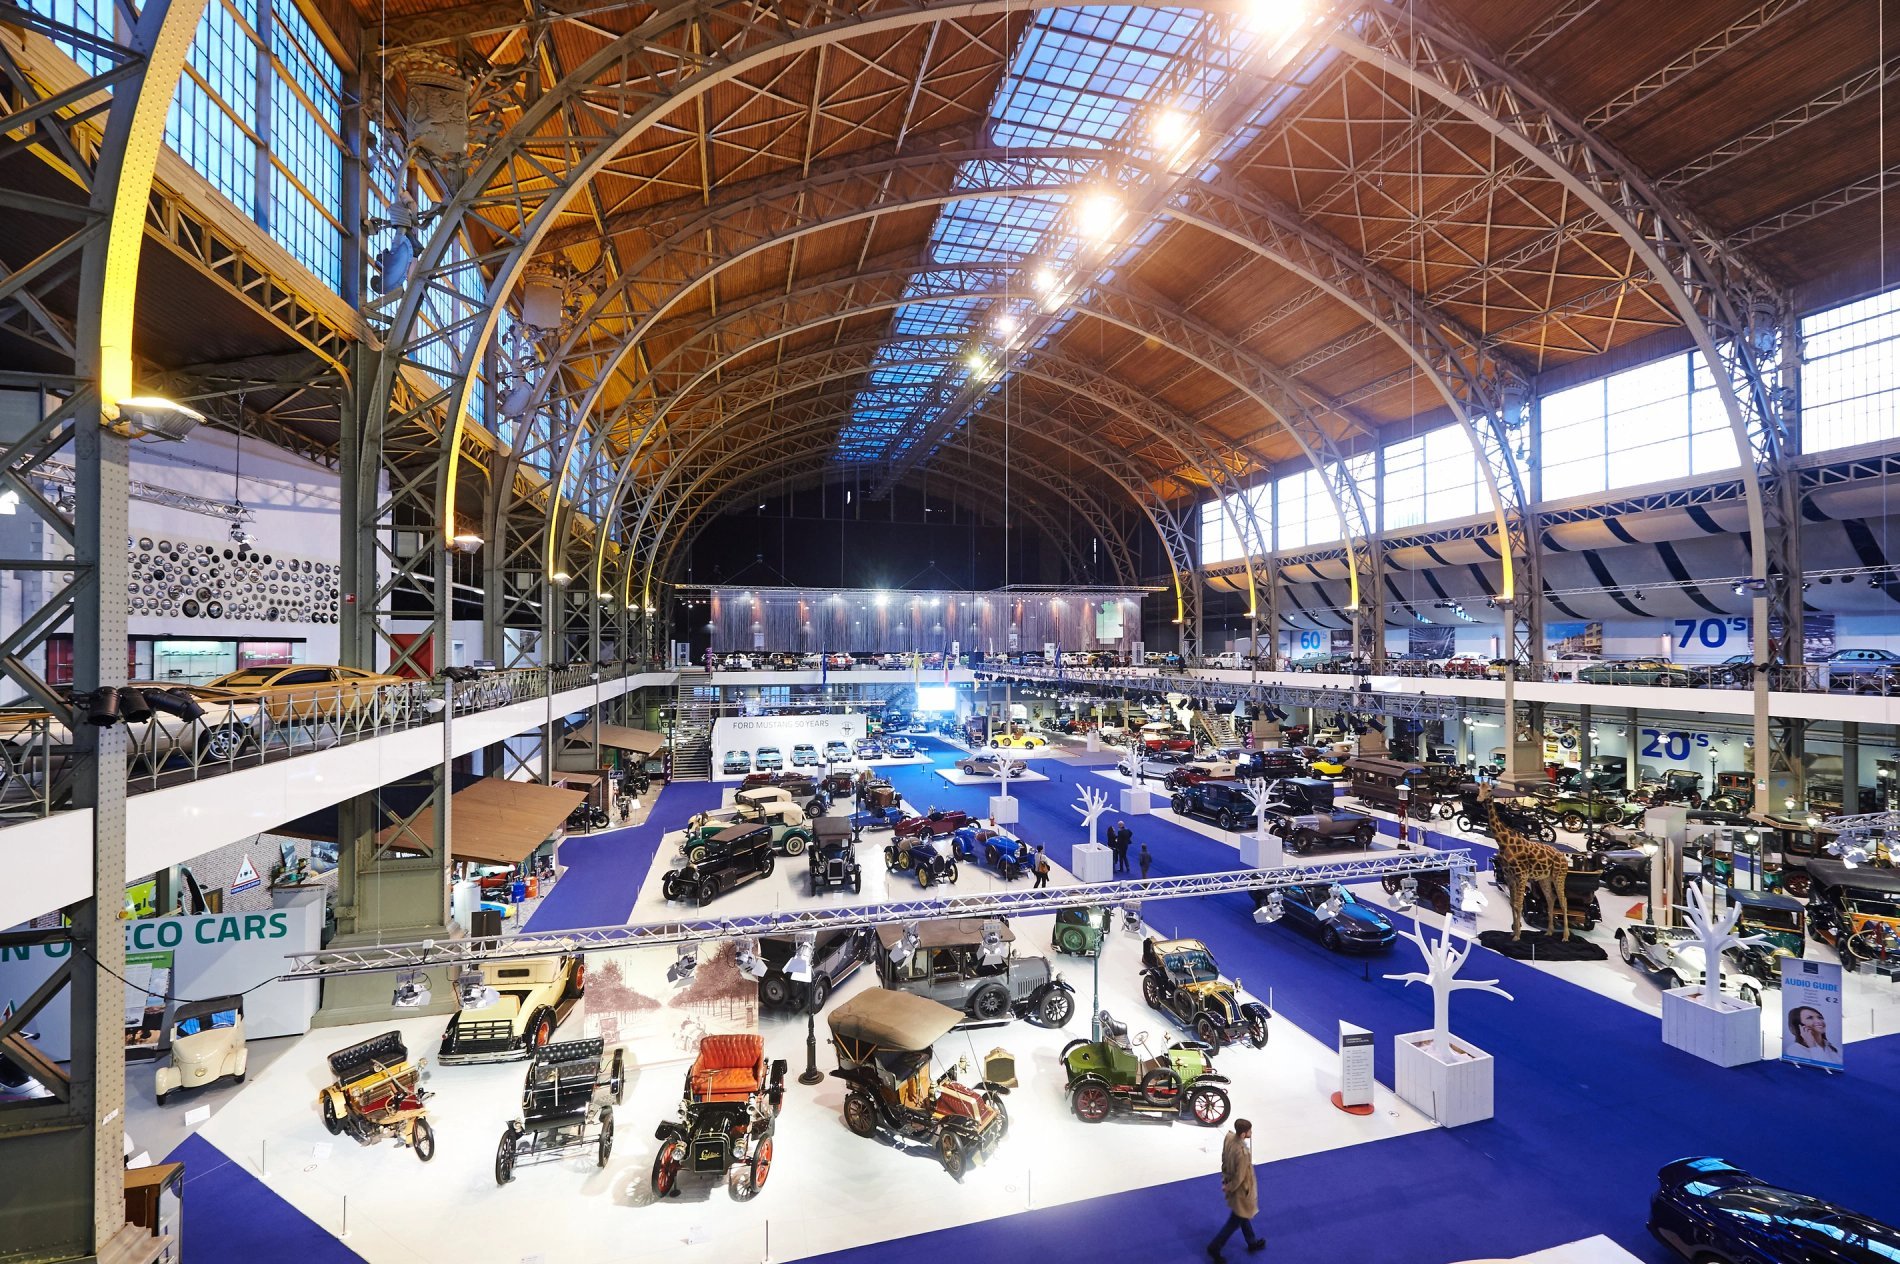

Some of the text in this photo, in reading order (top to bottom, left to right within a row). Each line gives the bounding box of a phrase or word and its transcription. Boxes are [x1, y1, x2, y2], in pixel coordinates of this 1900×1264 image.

[1300, 631, 1327, 649] 60's
[1675, 617, 1746, 648] 70's
[756, 721, 793, 729] MUSTANG
[806, 720, 829, 728] YEARS
[1642, 729, 1709, 760] 20's
[125, 921, 183, 950] CO
[195, 912, 287, 944] CARS
[1785, 978, 1838, 992] AUDIO GUIDE
